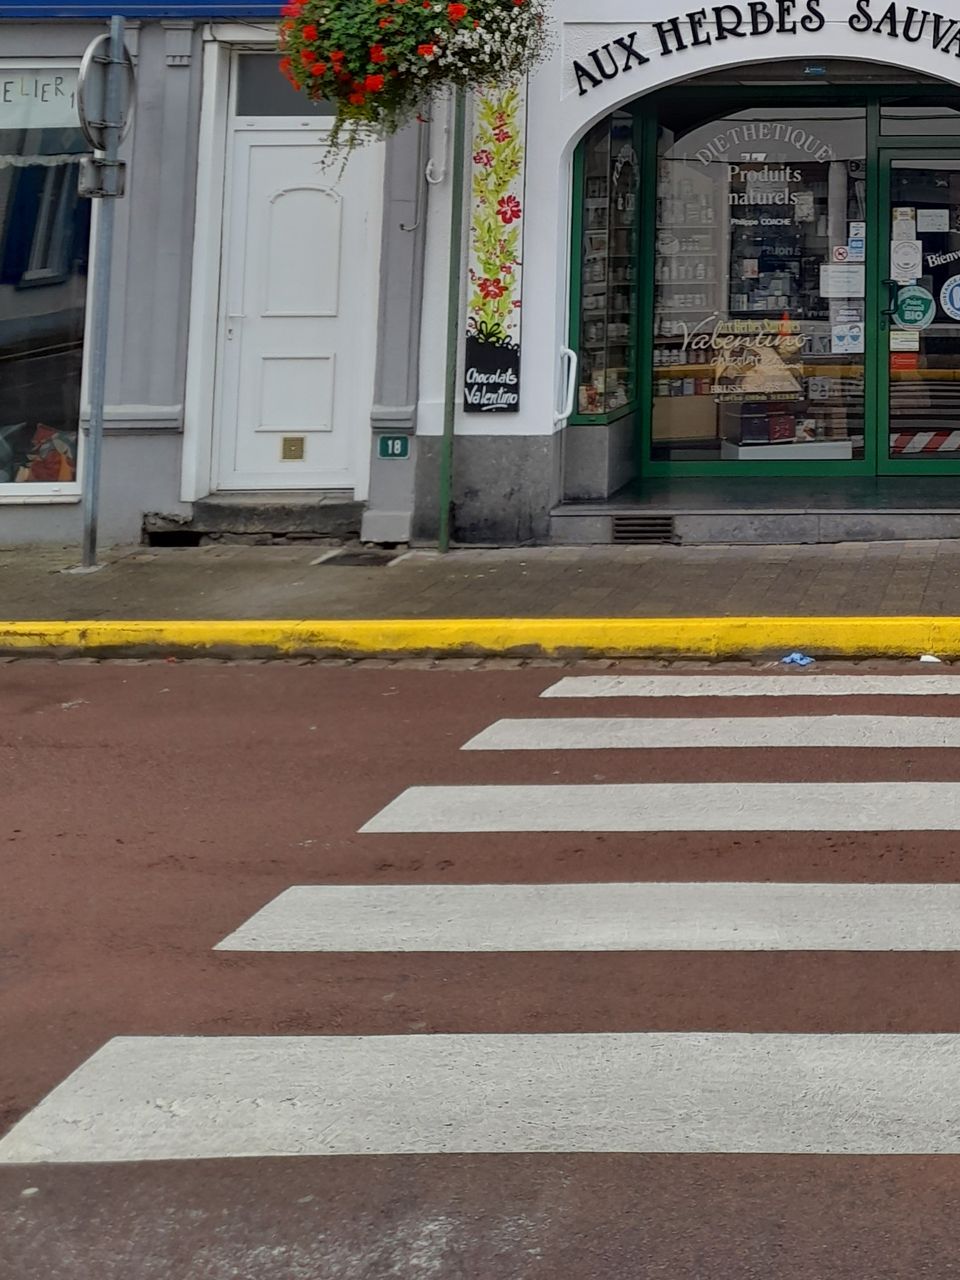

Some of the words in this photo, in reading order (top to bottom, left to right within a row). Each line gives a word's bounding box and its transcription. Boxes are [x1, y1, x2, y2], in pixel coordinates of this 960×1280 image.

[573, 31, 650, 97] AUX
[727, 164, 802, 183] Produits
[727, 186, 799, 206] naturels
[904, 310, 924, 320] BIO
[677, 311, 812, 351] Valentino
[466, 368, 518, 385] Chocolats
[464, 384, 518, 404] Valentino
[387, 439, 401, 454] 18
